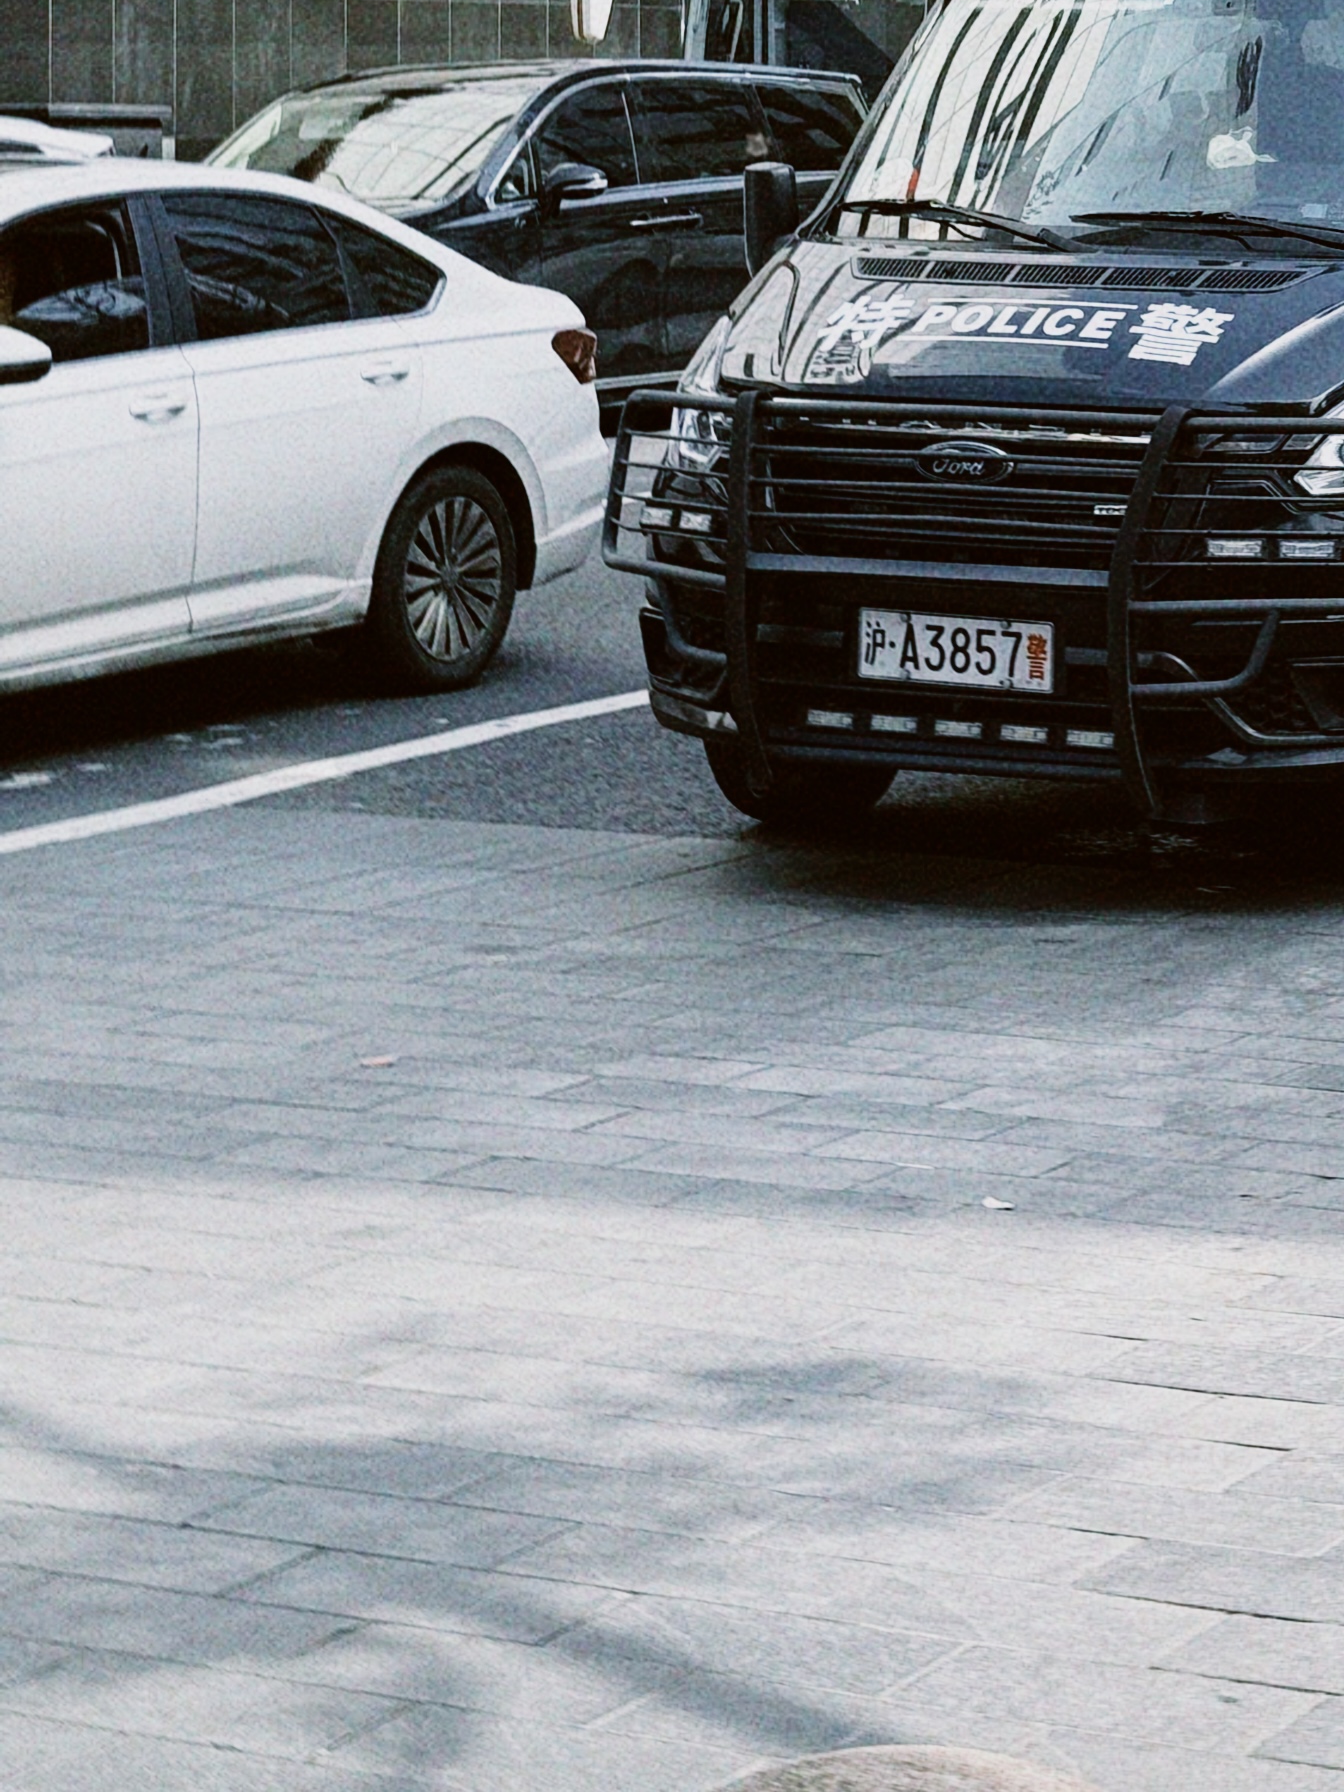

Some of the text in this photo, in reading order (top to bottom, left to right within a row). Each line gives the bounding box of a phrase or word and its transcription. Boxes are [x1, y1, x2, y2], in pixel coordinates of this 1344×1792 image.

[817, 293, 1236, 366] 特 POLICE 警
[933, 448, 986, 475] Ford
